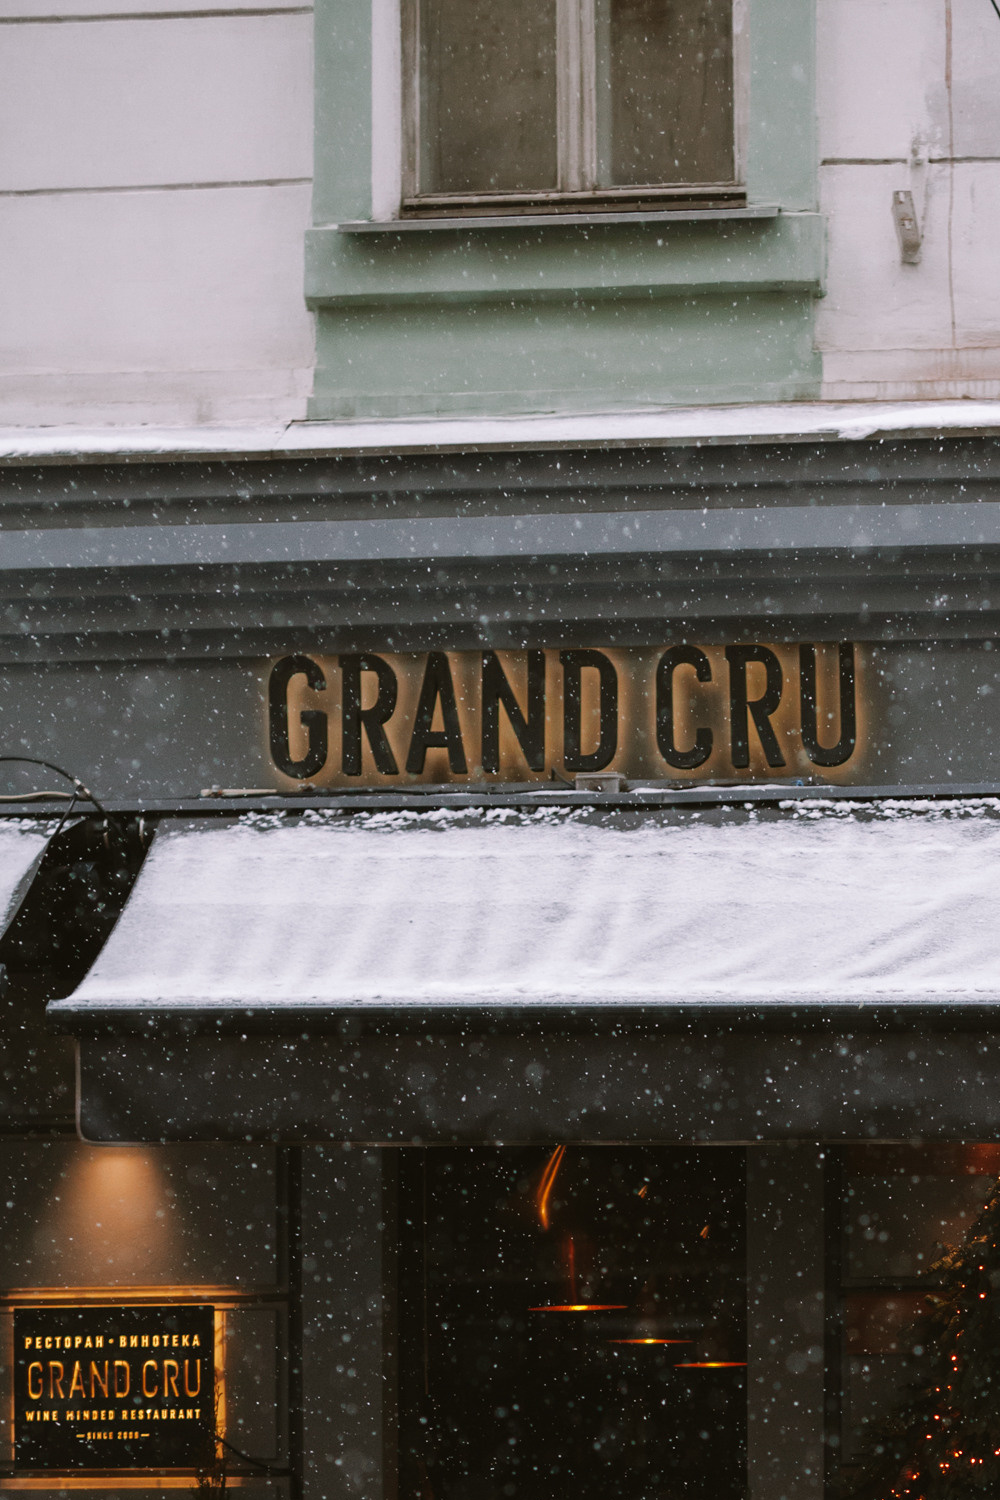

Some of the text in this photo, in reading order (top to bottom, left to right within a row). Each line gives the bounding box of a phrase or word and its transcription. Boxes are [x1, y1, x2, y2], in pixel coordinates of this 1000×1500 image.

[267, 642, 858, 779] GRAND CRU
[24, 1334, 202, 1349] РЕСТОРАН ВИНОТЕКА
[27, 1358, 202, 1399] GRAND CRU
[25, 1408, 202, 1422] WINE MINDED RESTAURANT
[86, 1431, 114, 1440] SINCE
